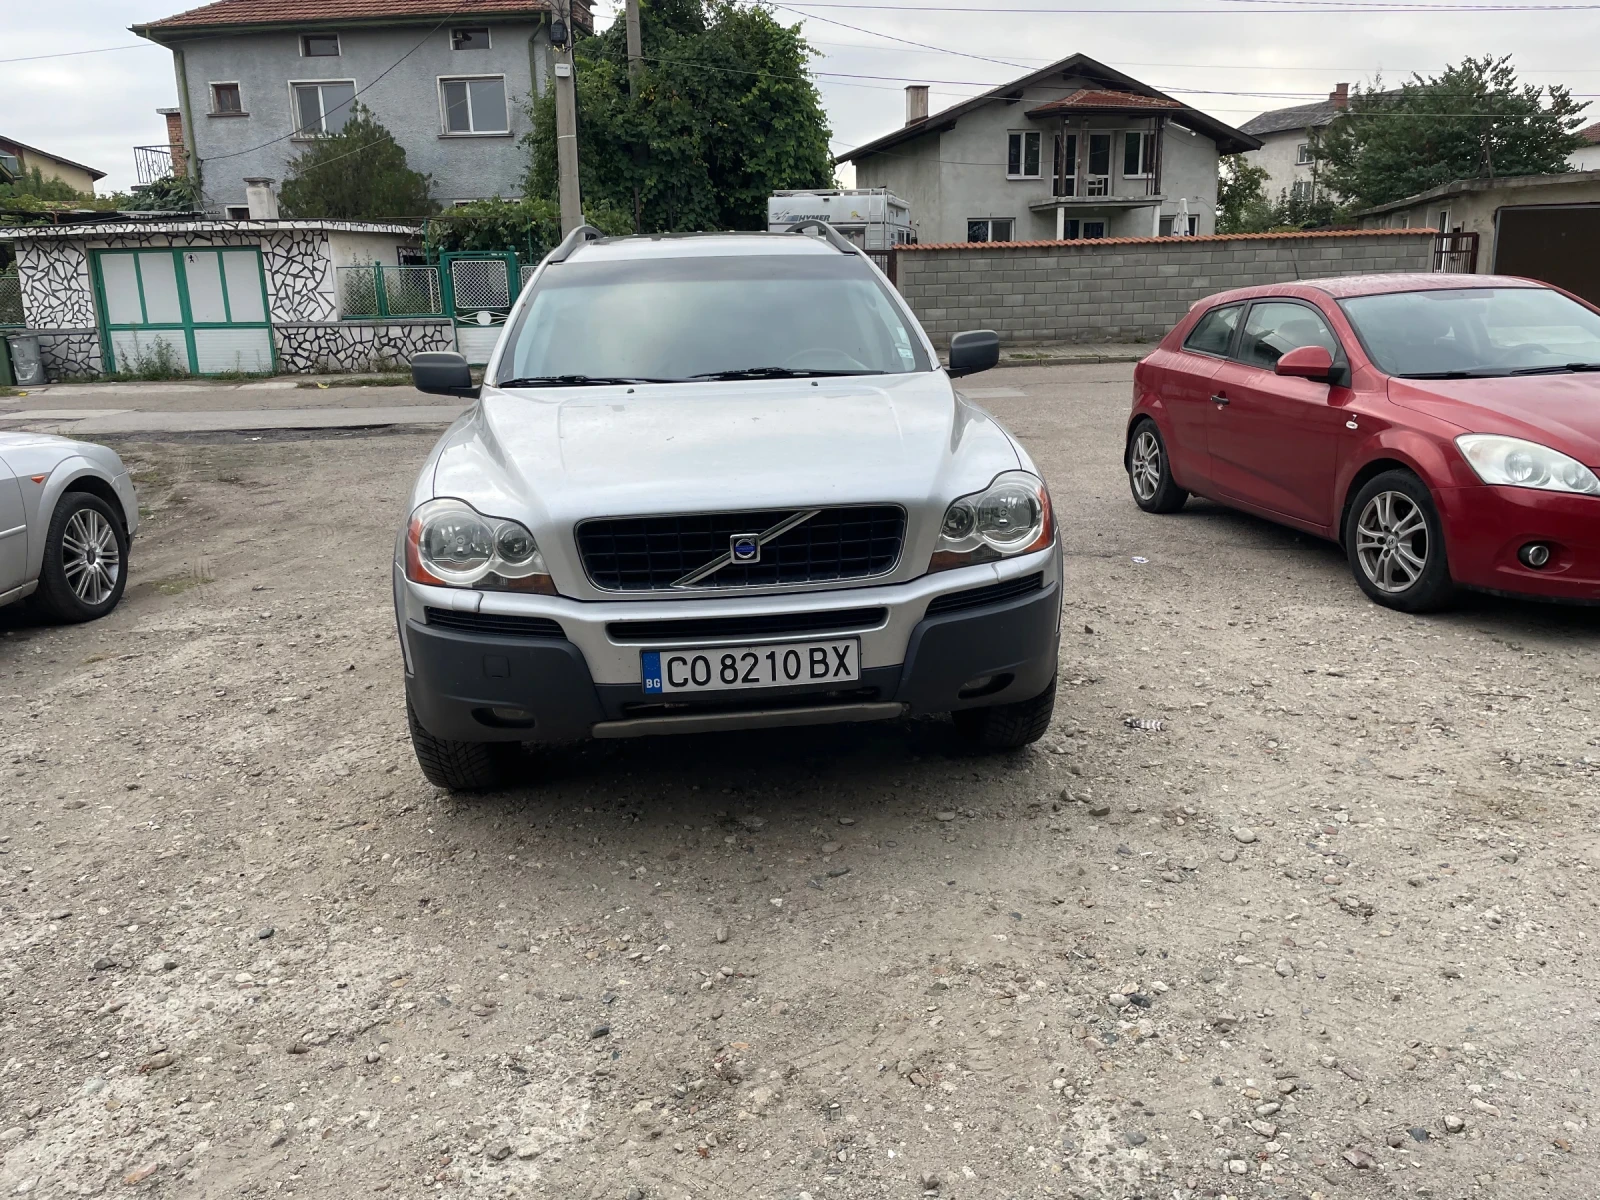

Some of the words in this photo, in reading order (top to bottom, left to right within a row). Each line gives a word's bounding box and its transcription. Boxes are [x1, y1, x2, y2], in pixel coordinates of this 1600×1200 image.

[799, 214, 831, 222] HYMER
[719, 649, 801, 685] 8210
[808, 645, 851, 679] BX
[646, 678, 661, 689] BG
